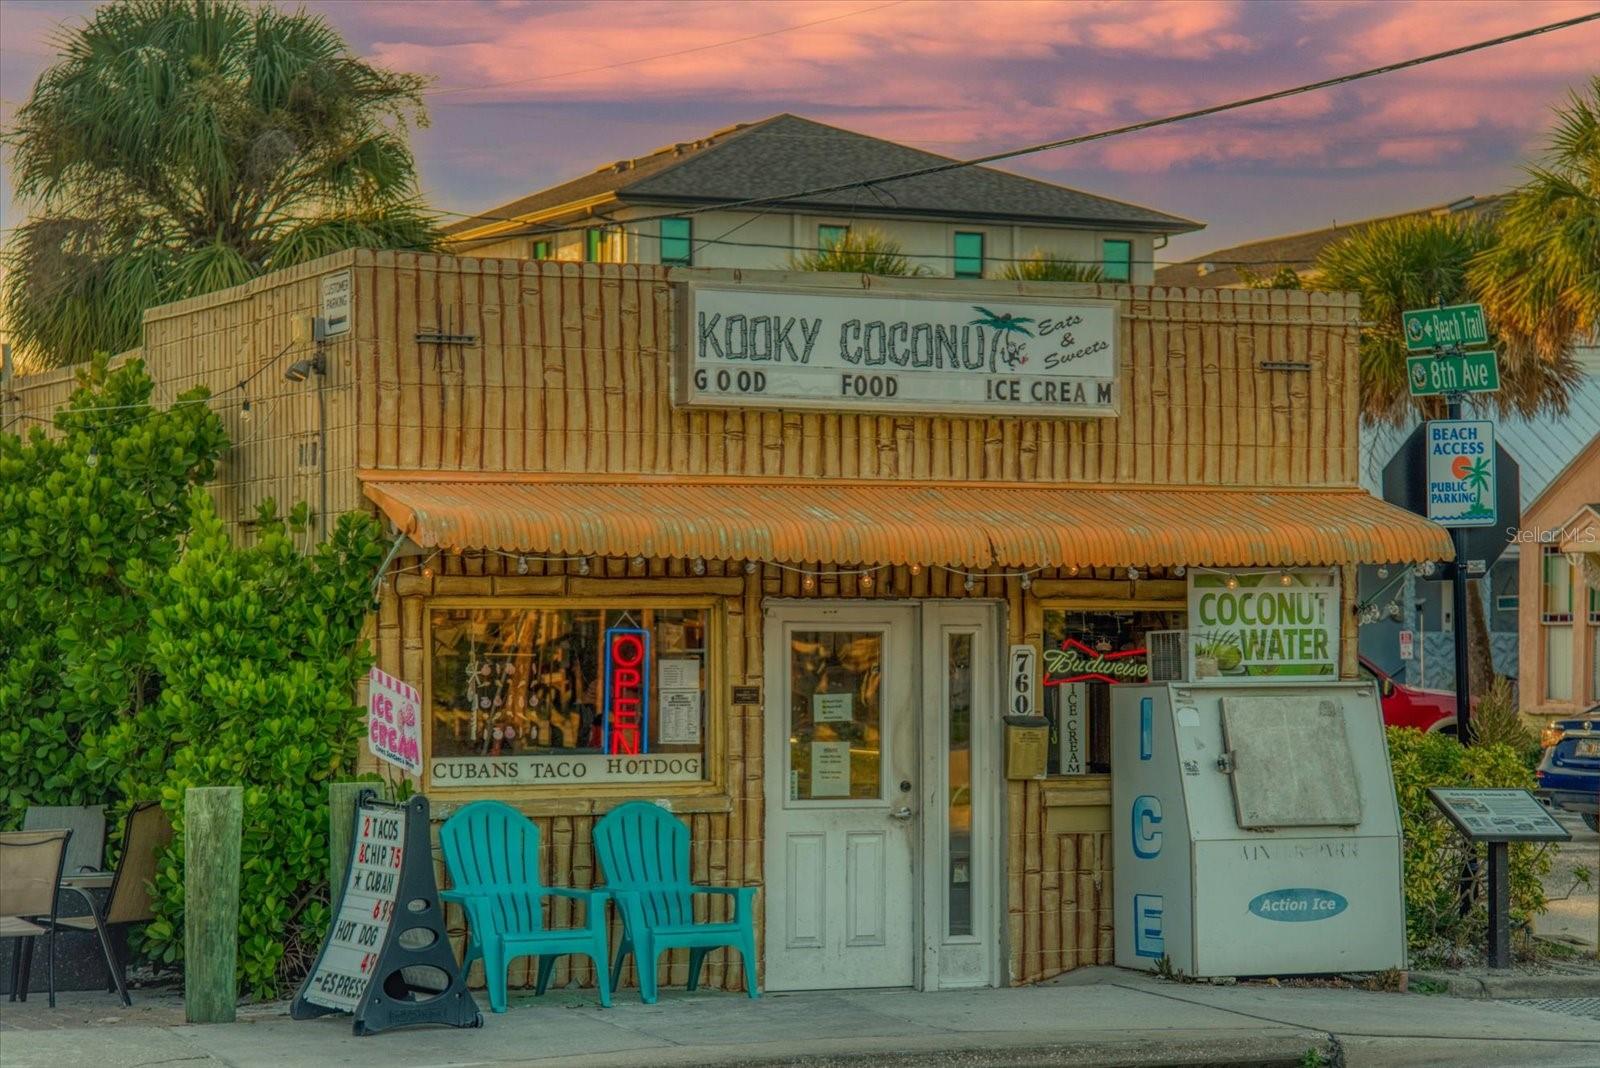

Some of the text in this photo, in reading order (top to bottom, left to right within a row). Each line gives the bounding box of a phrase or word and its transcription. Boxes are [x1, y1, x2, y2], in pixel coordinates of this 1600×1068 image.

[698, 311, 823, 364] KOOKY
[1038, 315, 1083, 336] Eats
[1432, 310, 1484, 342] Beach Trail
[1060, 332, 1075, 348] &
[1044, 340, 1109, 369] Sweets
[694, 368, 767, 392] GOOD
[841, 374, 898, 397] FOOD
[986, 379, 1020, 401] ICE
[1430, 359, 1488, 389] 8th Ave
[1433, 427, 1477, 440] BEACH
[1433, 442, 1485, 455] ACCESS
[1431, 481, 1467, 493] PUBLIC
[1431, 493, 1476, 503] PARKING
[1200, 592, 1329, 626] COCONUT
[1240, 628, 1329, 661] WATER
[1043, 649, 1149, 677] Budweise
[611, 634, 644, 757] OPEN
[1015, 653, 1029, 713] 760
[371, 693, 394, 724] ICE
[370, 718, 420, 766] CREAM
[1067, 683, 1080, 773] ICE CREAM
[432, 762, 519, 779] CUBANS
[530, 762, 587, 778] TACO
[607, 758, 699, 775] HOTDOG
[364, 816, 398, 840] 2 TACOS
[1131, 697, 1165, 958] ICE
[366, 871, 394, 894] CUBAN
[1260, 898, 1336, 911] Action Ice
[335, 921, 379, 946] HOT DOG
[321, 972, 367, 999] ESPRESS
